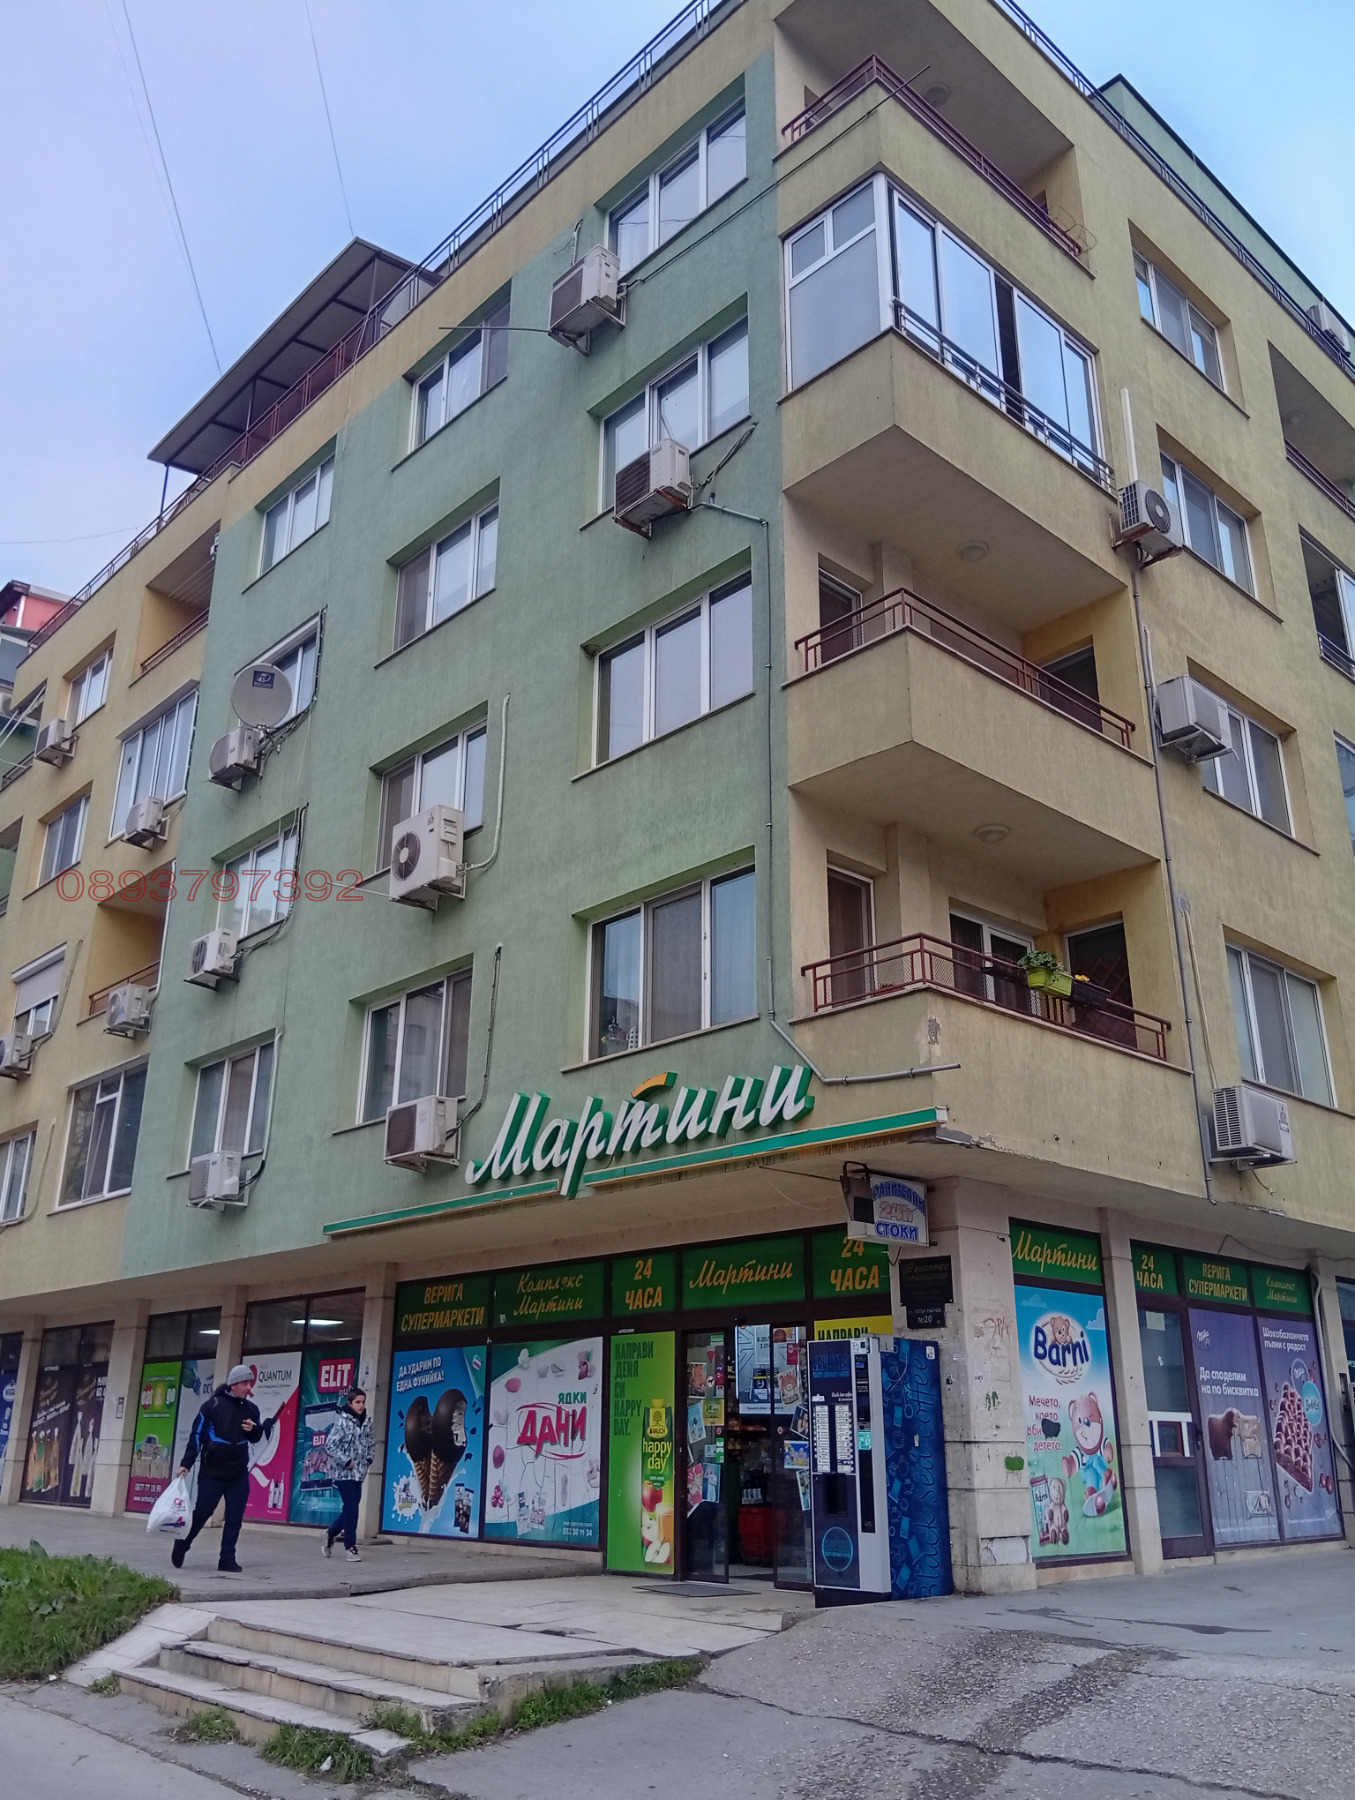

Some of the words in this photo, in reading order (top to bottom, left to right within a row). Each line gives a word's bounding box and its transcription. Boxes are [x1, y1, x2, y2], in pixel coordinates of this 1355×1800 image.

[464, 1064, 816, 1199] Мартини
[872, 1181, 926, 1217] РАНИТЕЛНИ
[875, 1221, 919, 1241] СТОКИ
[841, 1238, 864, 1257] 24
[1012, 1230, 1098, 1272] Мартини
[633, 1258, 653, 1280] 24
[1141, 1254, 1155, 1271] 24
[1202, 1263, 1231, 1281] ВЕРИГА
[516, 1272, 584, 1295] Комплекс
[689, 1258, 793, 1294] Мартини
[830, 1265, 880, 1291] ЧАСА
[1136, 1271, 1164, 1290] ЧАСА
[1265, 1275, 1296, 1291] Комплекс
[423, 1283, 464, 1305] ВЕРИГА
[625, 1286, 663, 1311] ЧАСА
[1188, 1278, 1248, 1302] СУПЕРМАРКЕТИ
[1266, 1288, 1298, 1304] Мартини
[513, 1294, 584, 1321] Мартини
[401, 1306, 485, 1332] СУПЕРМАРКЕТИ
[614, 1341, 654, 1361] НАПРАВИ
[1034, 1324, 1090, 1367] Barni
[258, 1370, 292, 1383] QUANTUM
[399, 1366, 408, 1378] ДА
[408, 1359, 432, 1375] УДАРИМ
[432, 1356, 442, 1368] ПО
[614, 1360, 639, 1380] ДЕНЯ
[1199, 1366, 1210, 1381] Да
[1210, 1370, 1248, 1383] споделим
[396, 1379, 412, 1392] ЕДНА
[413, 1370, 444, 1387] ФУНИЙКА!
[614, 1381, 626, 1399] СИ
[1201, 1384, 1211, 1394] на
[1211, 1385, 1221, 1395] по
[1222, 1382, 1259, 1397] бисквитка
[557, 1391, 588, 1404] ЯДКИ
[1028, 1395, 1061, 1408] Мечето,
[614, 1399, 642, 1417] HAPPY
[1034, 1410, 1059, 1422] което
[516, 1405, 587, 1460] ДАНИ
[613, 1417, 631, 1436] DAY.
[642, 1437, 673, 1458] happy
[1033, 1440, 1063, 1452] детето.
[647, 1453, 668, 1474] day
